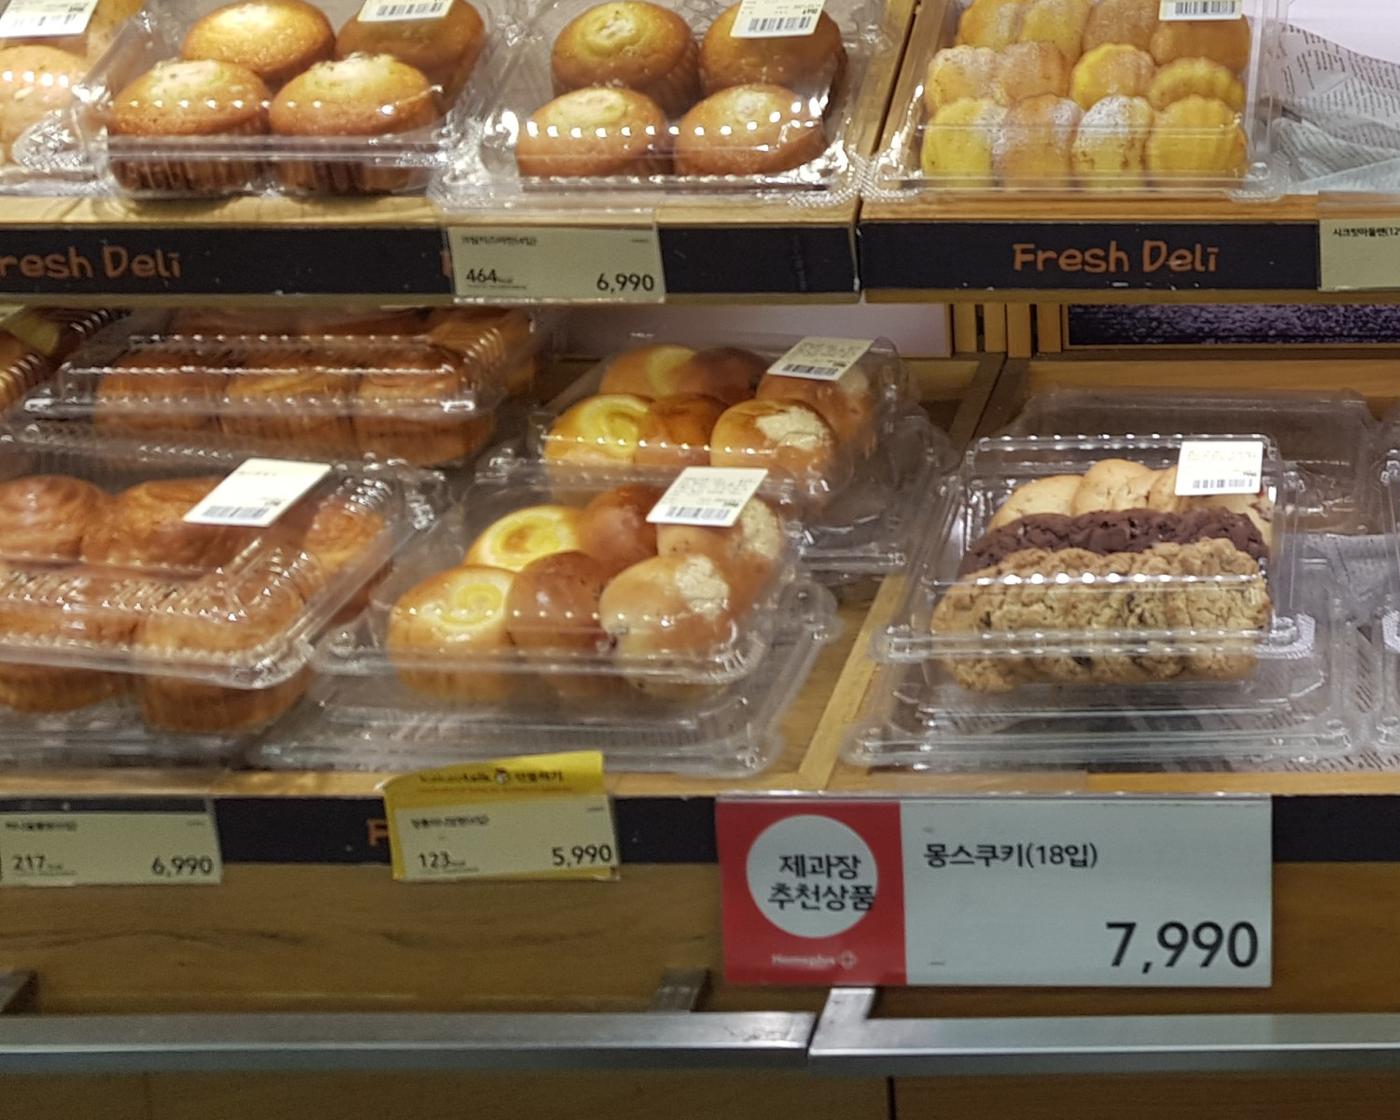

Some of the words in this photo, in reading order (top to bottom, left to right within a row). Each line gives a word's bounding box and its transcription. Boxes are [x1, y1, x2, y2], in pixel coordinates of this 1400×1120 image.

[0, 246, 94, 278] resh
[103, 245, 181, 278] Deli
[1012, 242, 1130, 273] Fresh
[1142, 240, 1220, 273] Deli
[466, 268, 498, 284] 464
[597, 273, 654, 293] 6,990
[152, 856, 213, 877] 6,990
[419, 852, 451, 868] 123
[552, 843, 612, 868] 5,990
[778, 853, 862, 881] 제과장
[924, 843, 1099, 870] 몽스쿠키(18입)
[768, 883, 876, 912] 추천상품
[1105, 921, 1260, 974] 7,990
